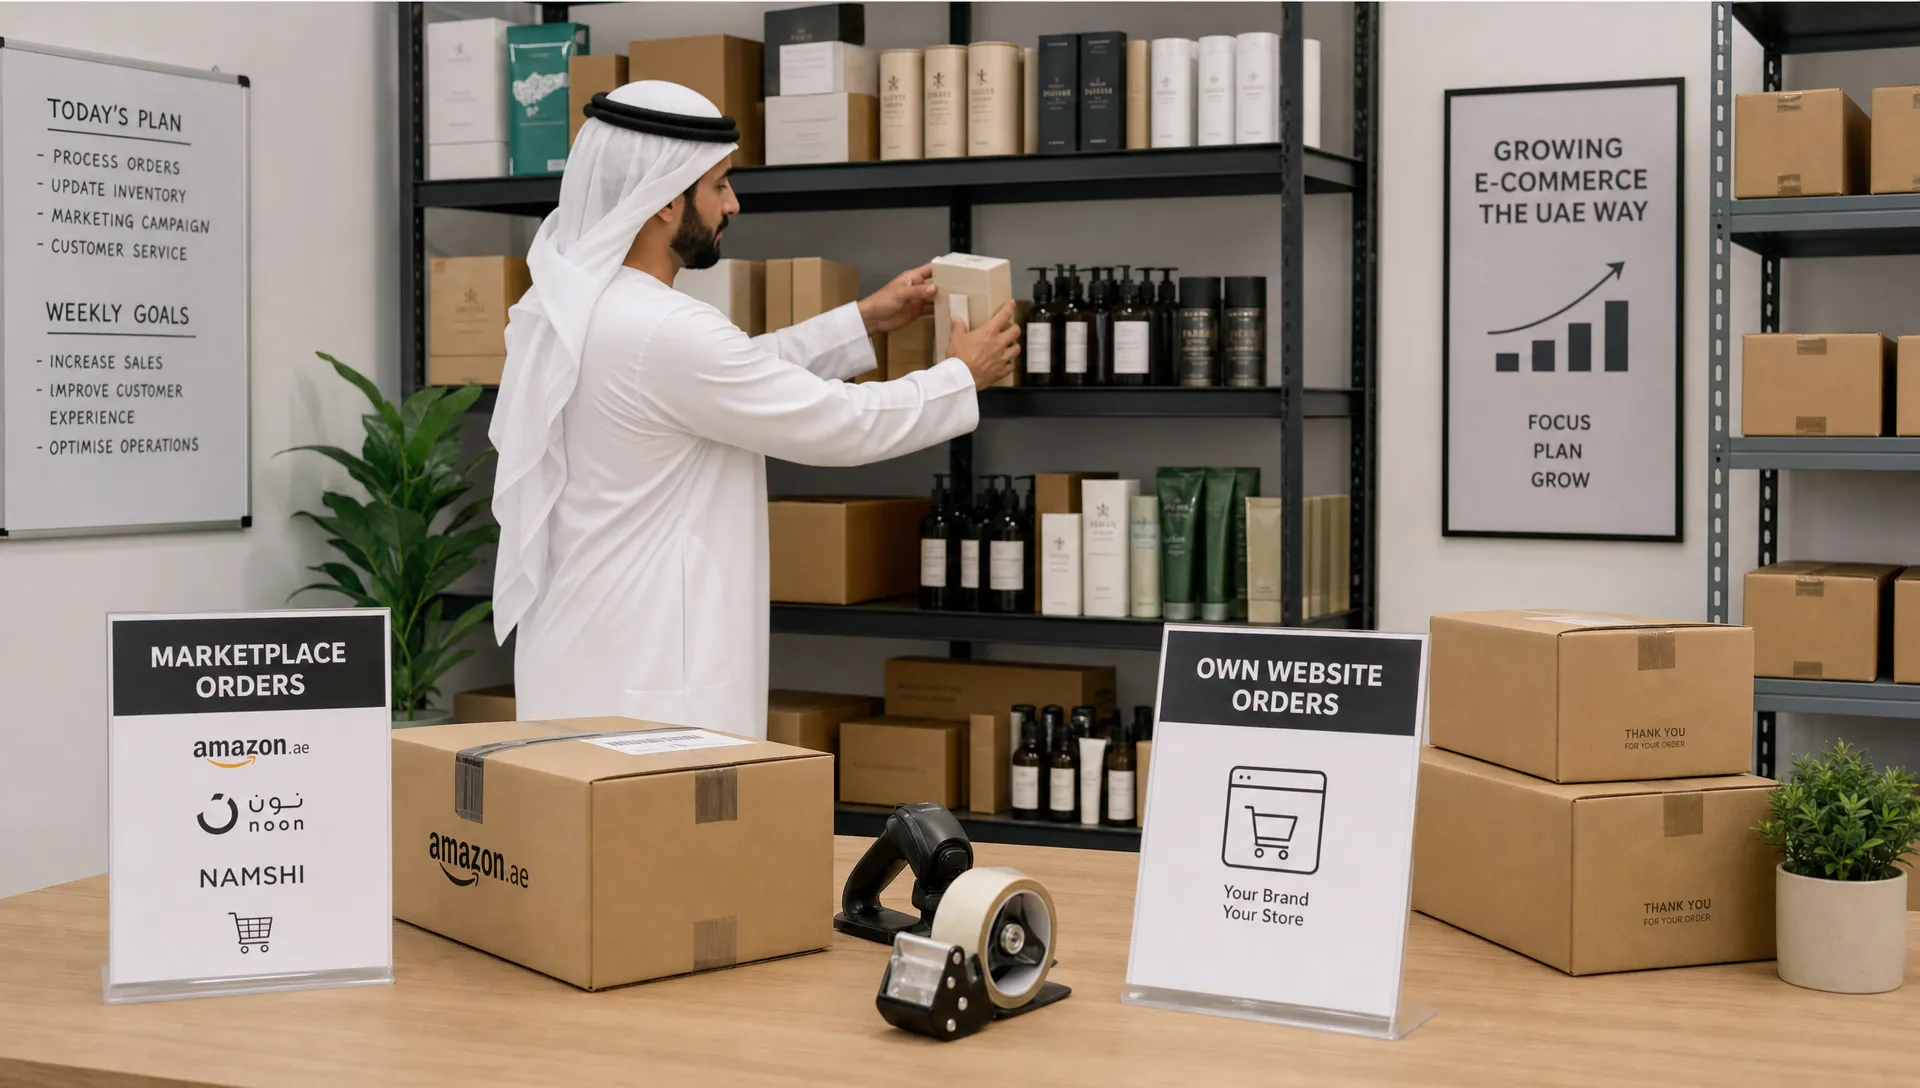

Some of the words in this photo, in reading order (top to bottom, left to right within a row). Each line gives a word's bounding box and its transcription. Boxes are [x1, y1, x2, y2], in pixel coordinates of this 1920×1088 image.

[46, 97, 129, 127] TODAY'S
[138, 109, 181, 133] PLAN
[1493, 137, 1623, 162] GROWING
[53, 148, 119, 169] PROCESS
[126, 156, 180, 176] ORDERS
[51, 178, 105, 197] UPDATE
[113, 183, 187, 204] INVENTORY
[1475, 168, 1648, 193] E-COMMERCE
[51, 208, 134, 230] MARKETING
[141, 215, 210, 234] CAMPAIGN
[1478, 202, 1528, 225] THE
[1536, 202, 1586, 224] UAE
[1592, 200, 1649, 223] WAY
[51, 238, 125, 257] CUSTOMER
[132, 243, 187, 262] SERVICE
[45, 301, 123, 323] WEEKLY
[133, 303, 190, 326] GOALS
[50, 354, 116, 370] INCREASE
[124, 354, 163, 370] SALES
[50, 382, 109, 398] IMPROVE
[116, 383, 184, 398] CUSTOMER
[50, 409, 135, 426] EXPERIENCE
[1528, 414, 1591, 431] FOCUS
[49, 439, 113, 456] OPTIMISE
[120, 436, 199, 454] OPERATIONS
[1533, 442, 1582, 460] PLAN
[1531, 471, 1591, 489] GROW
[151, 641, 347, 668] MARKETPLACE
[1196, 657, 1260, 681] OWN
[1267, 660, 1383, 687] WEBSITE
[195, 673, 306, 699] ORDERS
[1232, 688, 1339, 716] ORDERS
[1624, 727, 1662, 739] THANK
[1663, 727, 1686, 738] YOU
[1624, 742, 1639, 751] FOR
[248, 792, 303, 816] نون
[249, 818, 304, 833] noon
[200, 864, 304, 888] NAMSHI
[1223, 884, 1259, 902] Your
[1262, 888, 1310, 907] Brand
[1643, 901, 1684, 914] THANK
[1687, 897, 1712, 911] YOU
[1223, 904, 1258, 922] Your
[1261, 908, 1304, 927] Store
[1643, 917, 1660, 927] FOR
[1660, 915, 1683, 925] YOUR
[1684, 913, 1711, 923] ORDER
